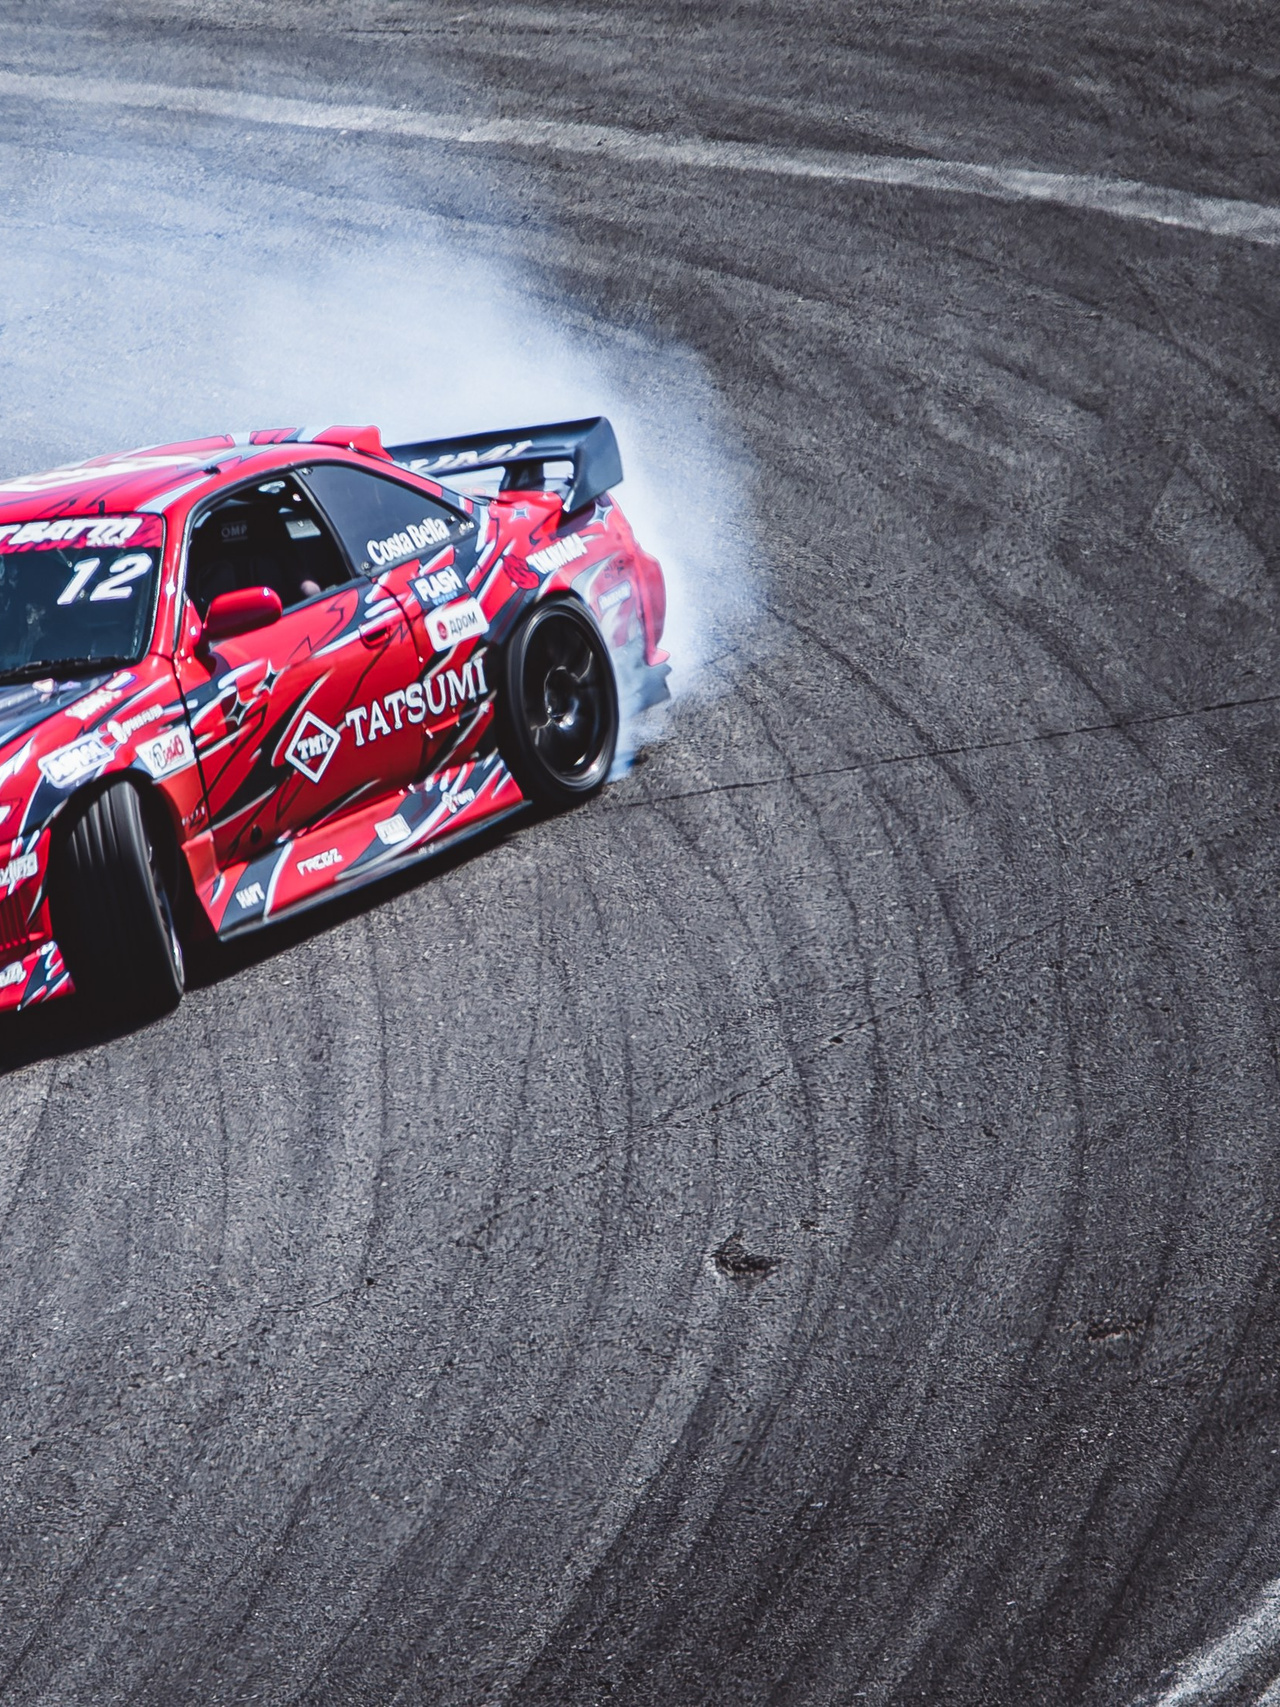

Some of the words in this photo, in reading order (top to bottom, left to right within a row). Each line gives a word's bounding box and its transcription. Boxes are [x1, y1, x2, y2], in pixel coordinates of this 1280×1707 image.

[221, 524, 248, 538] OMP
[366, 531, 417, 566] Costa
[406, 517, 451, 549] Bella
[57, 552, 154, 606] 12
[414, 566, 464, 602] FLASH
[345, 657, 489, 747] TATSUMI
[297, 733, 329, 761] TMI
